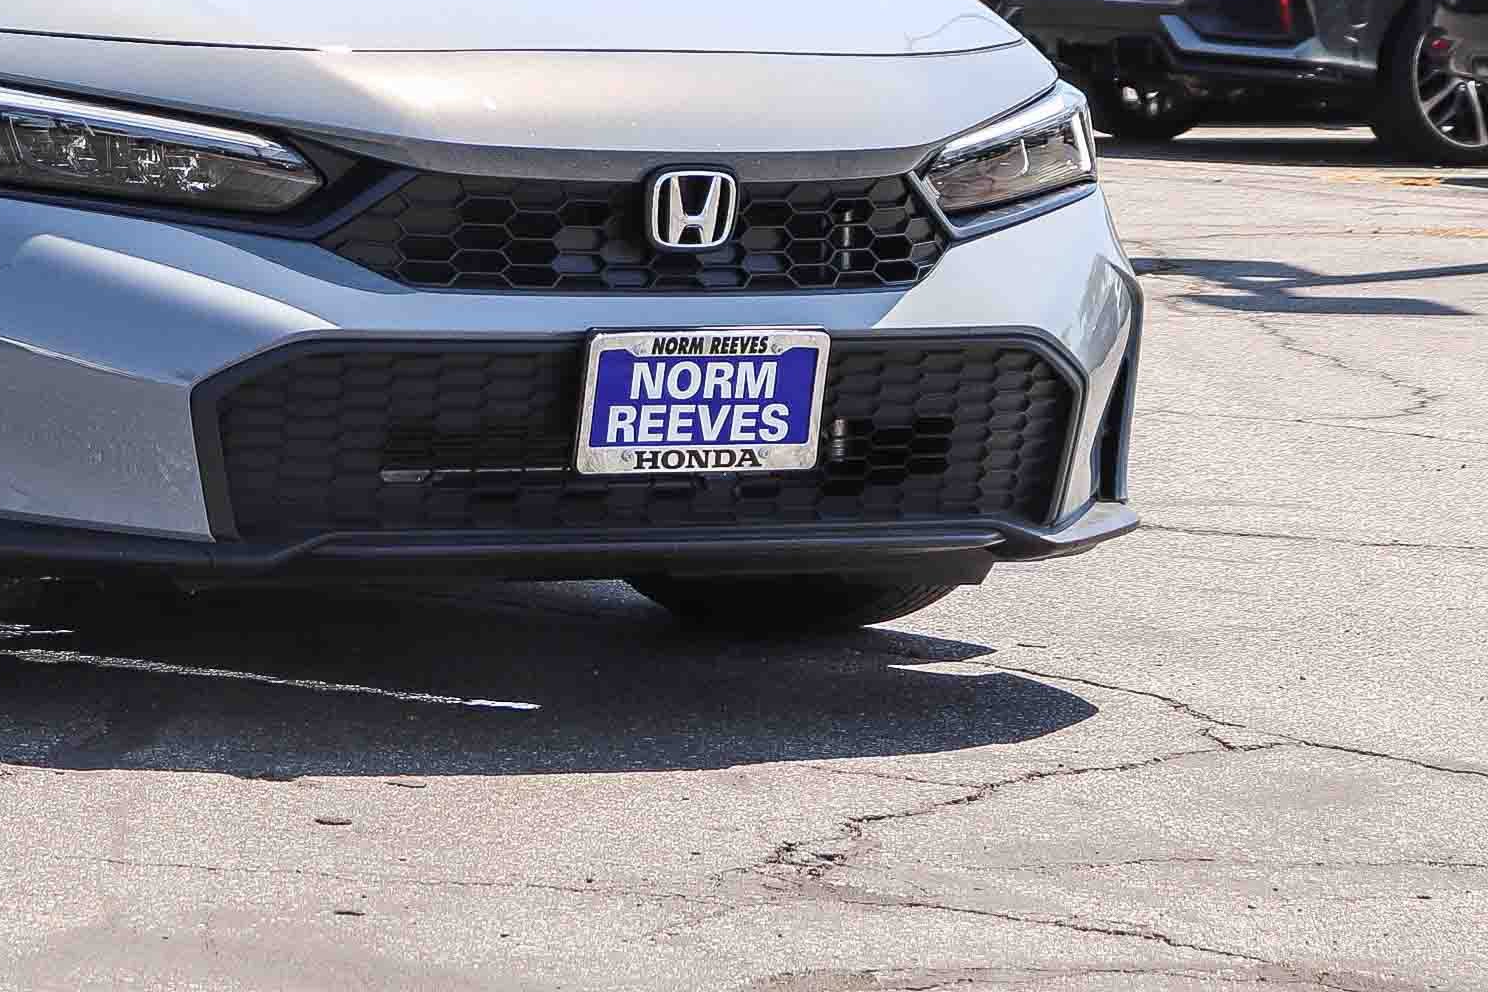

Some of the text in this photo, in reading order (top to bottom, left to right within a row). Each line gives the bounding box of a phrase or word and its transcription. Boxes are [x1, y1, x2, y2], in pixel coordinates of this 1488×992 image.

[651, 335, 769, 356] NORM REEVES
[629, 360, 778, 401] NORM
[606, 402, 790, 443] REEVES
[633, 448, 762, 470] HONDA
